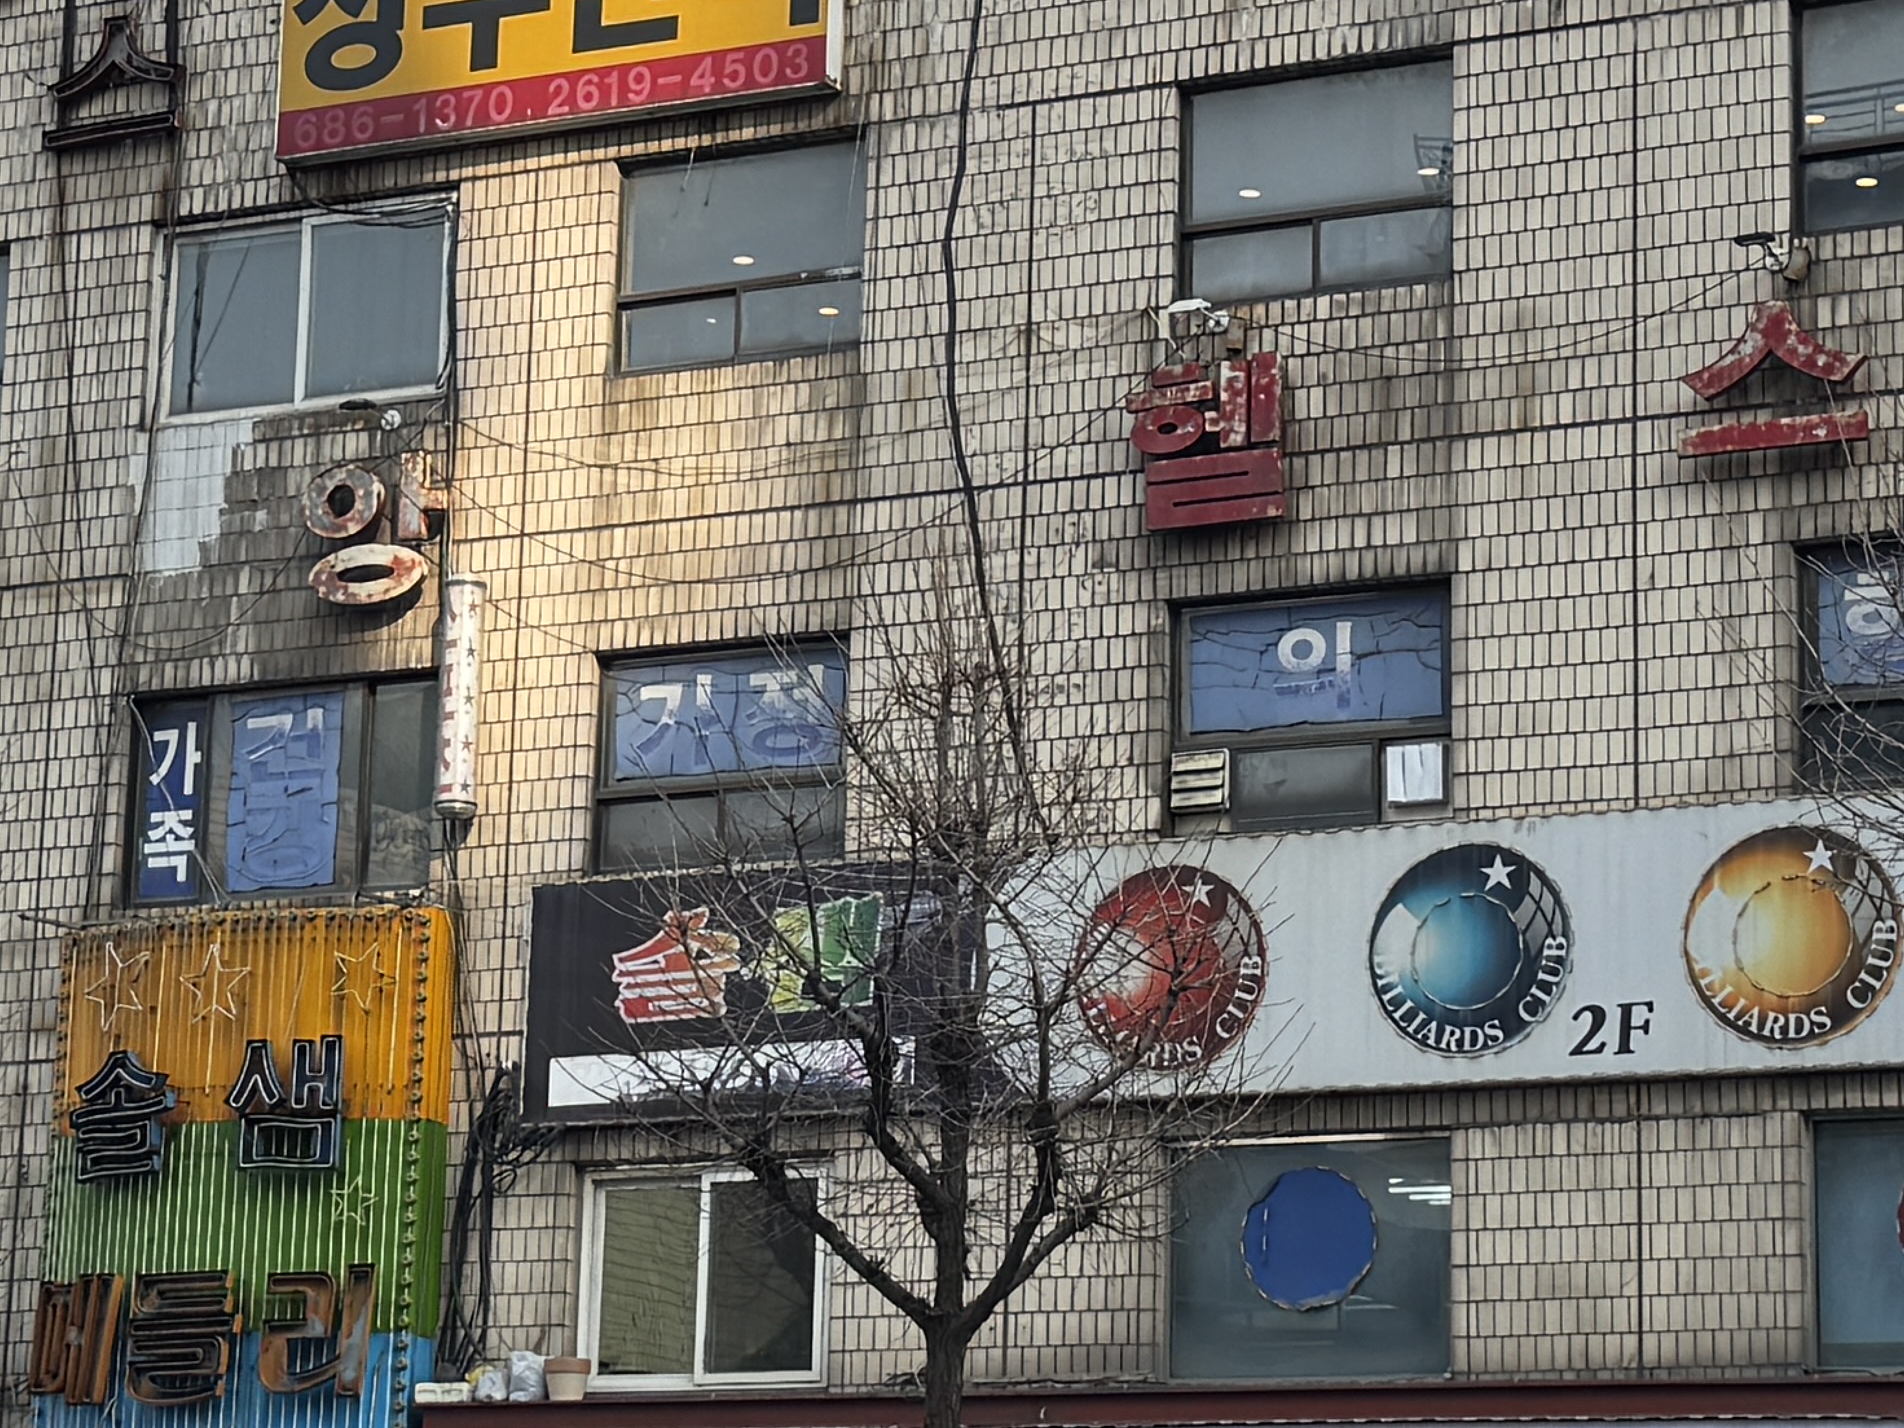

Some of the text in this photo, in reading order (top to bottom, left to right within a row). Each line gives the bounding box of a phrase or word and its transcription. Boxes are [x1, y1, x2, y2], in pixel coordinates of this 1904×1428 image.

[546, 42, 810, 115] 2619-4503
[142, 719, 203, 884] 가족
[1517, 933, 1569, 1022] CLUB
[1846, 917, 1900, 1012] CLUB
[1569, 999, 1656, 1057] 2F
